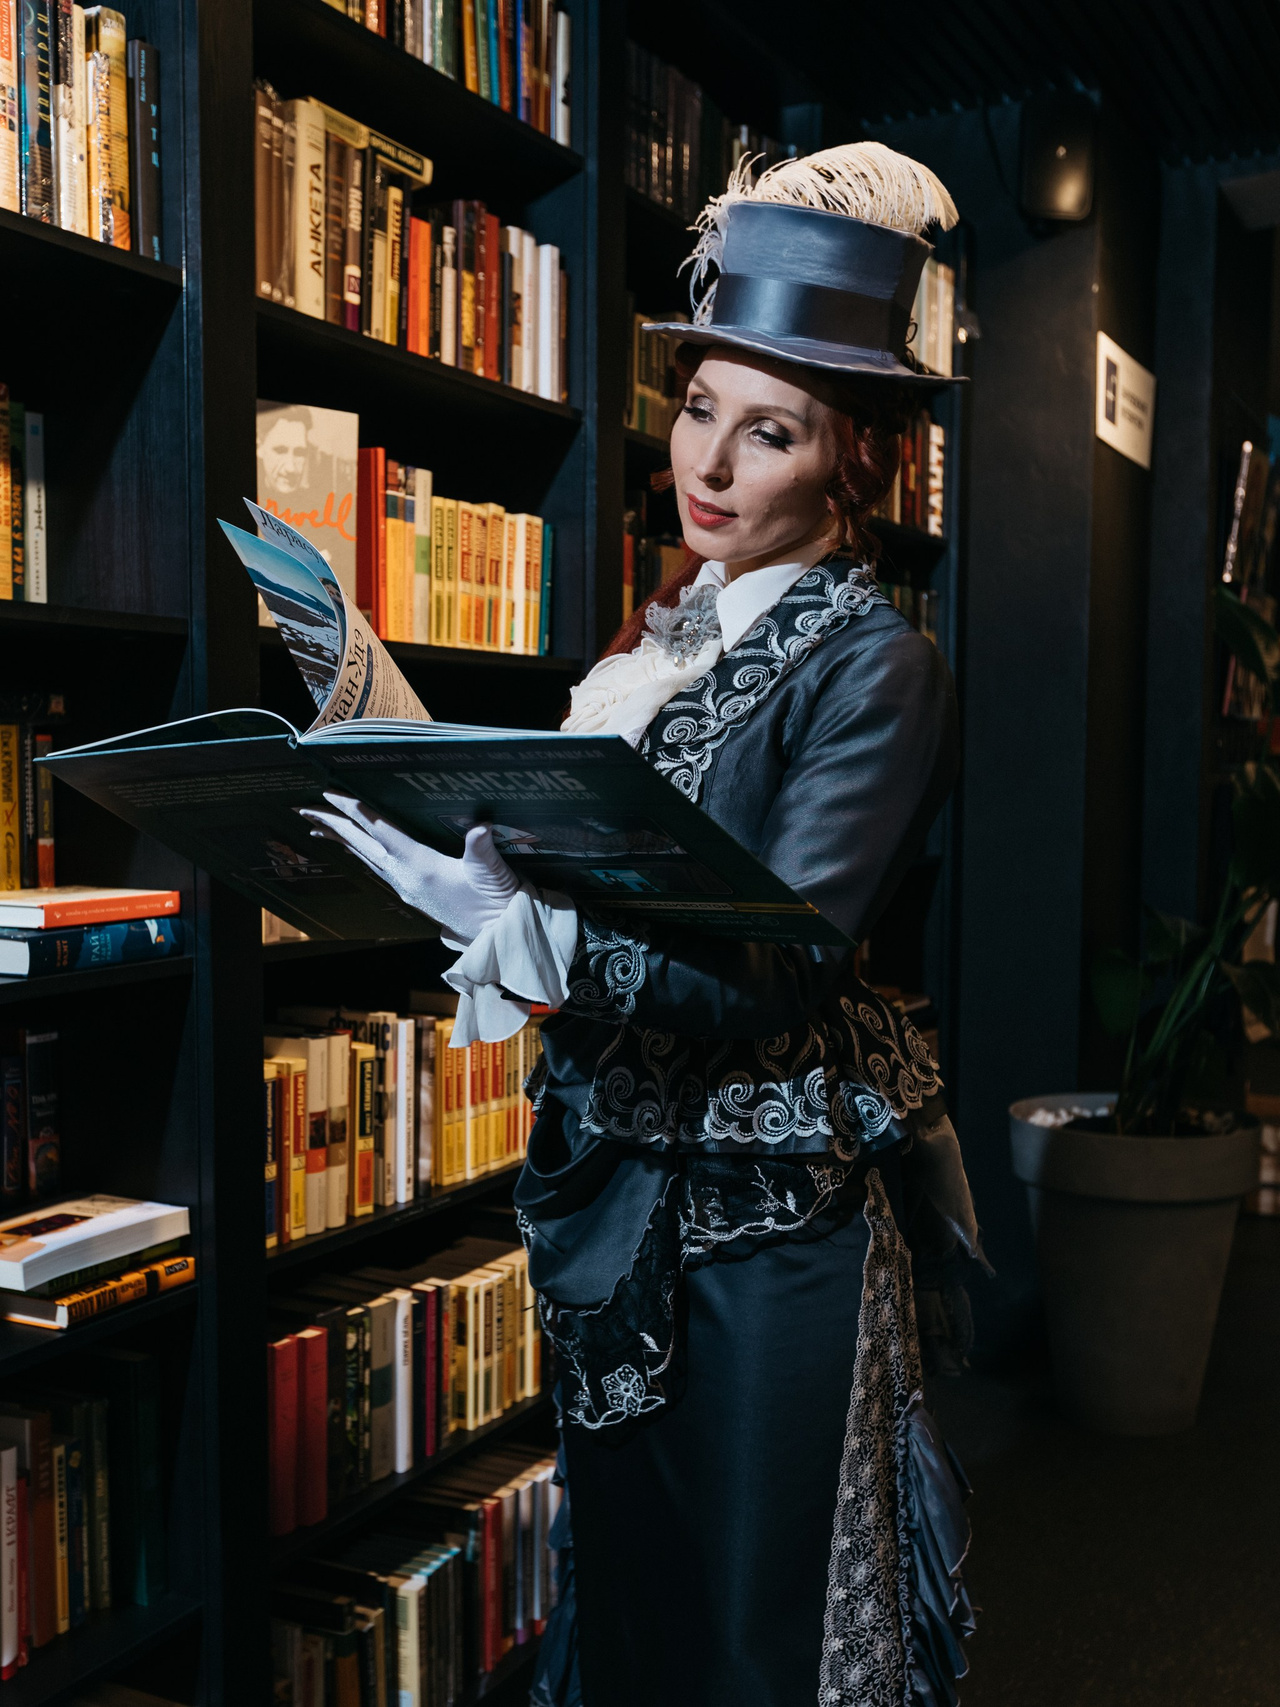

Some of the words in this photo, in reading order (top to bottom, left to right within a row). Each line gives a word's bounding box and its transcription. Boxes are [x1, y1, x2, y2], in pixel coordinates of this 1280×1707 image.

[309, 164, 322, 277] АНКЕТА
[261, 492, 358, 541] rwell
[393, 770, 588, 793] ТРАНССИБ
[91, 935, 100, 962] РАЙ
